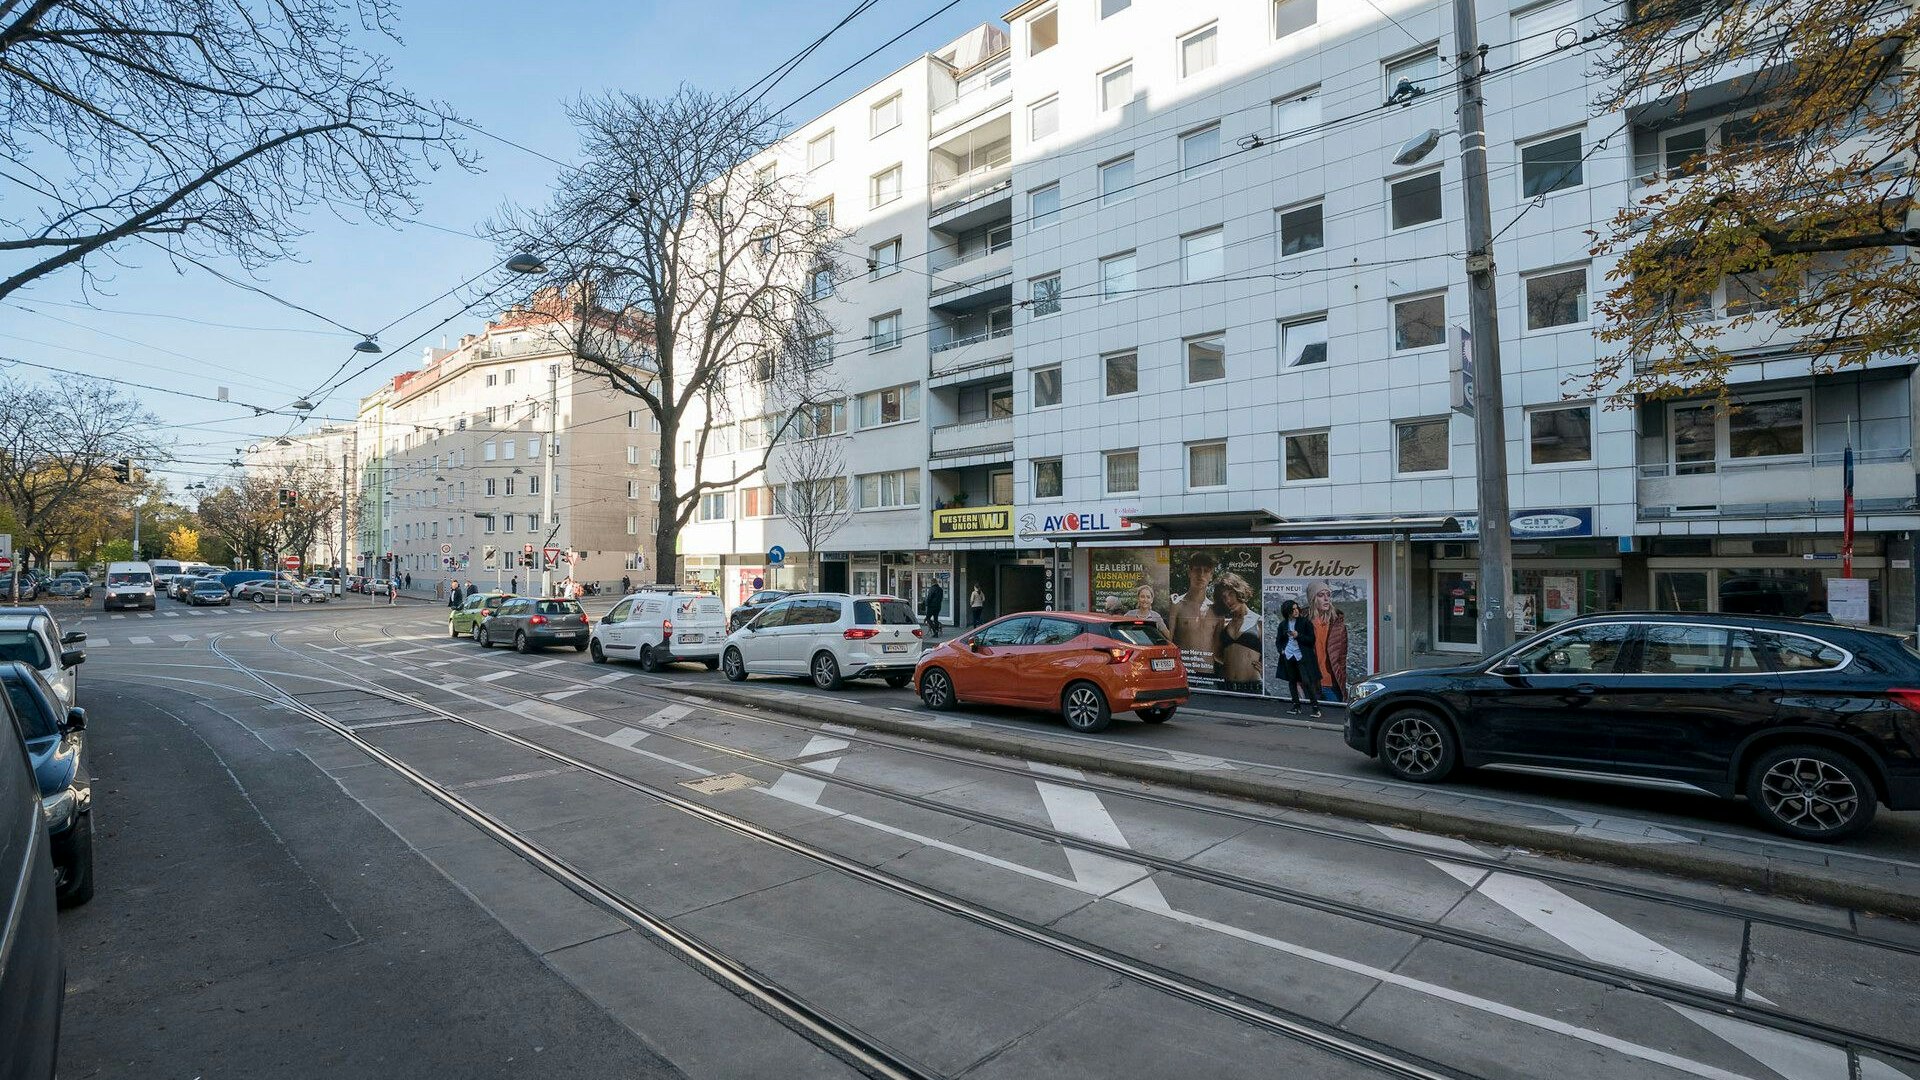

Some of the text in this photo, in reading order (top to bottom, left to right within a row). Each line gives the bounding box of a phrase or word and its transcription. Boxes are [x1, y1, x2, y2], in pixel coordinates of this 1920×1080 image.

[941, 514, 978, 524] WESTERN
[980, 512, 1005, 530] WU
[1520, 518, 1566, 526] CITY
[952, 522, 978, 530] UNION
[1095, 563, 1144, 572] LEA LEBT IM
[1293, 560, 1360, 577] Tchibo
